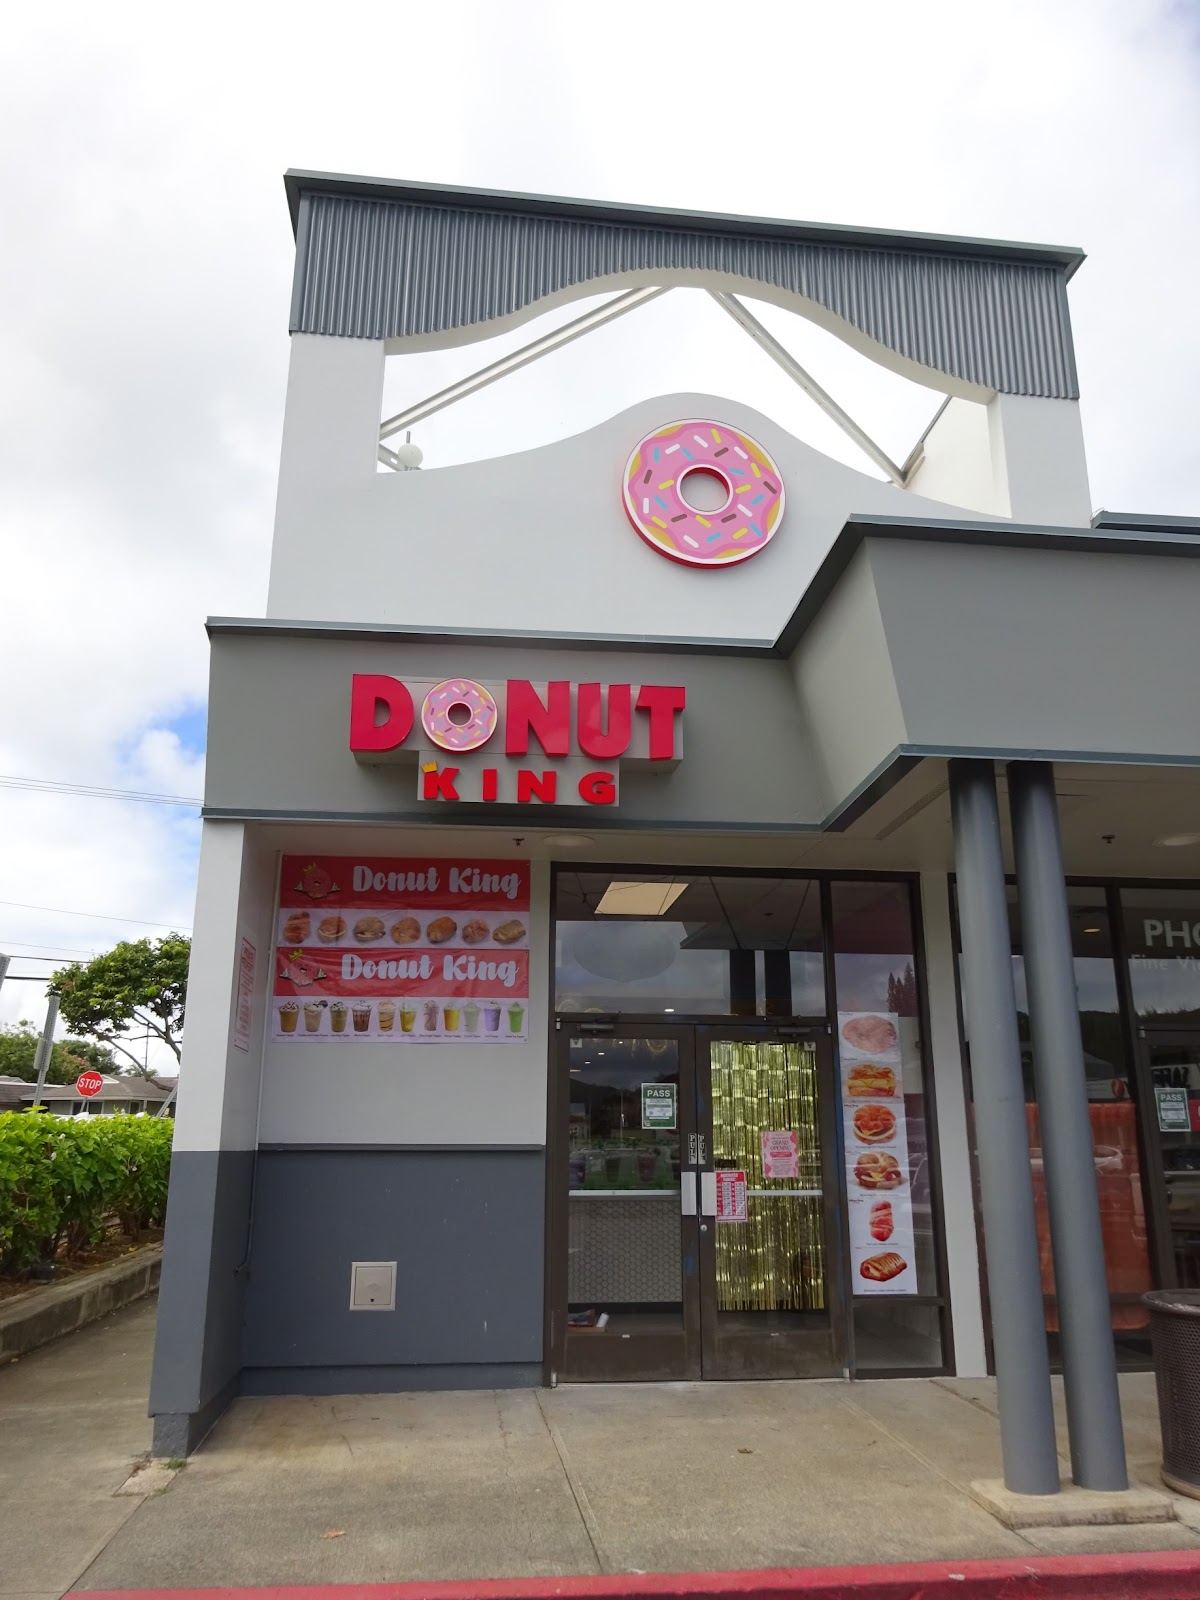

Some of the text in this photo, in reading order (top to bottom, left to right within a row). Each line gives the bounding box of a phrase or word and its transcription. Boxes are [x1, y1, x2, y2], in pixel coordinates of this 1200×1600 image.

[423, 767, 616, 805] KING
[353, 866, 520, 899] Donut King
[341, 953, 519, 987] Donut King
[1176, 954, 1200, 972] Vi
[78, 1078, 102, 1090] STOP
[647, 1089, 671, 1098] PASS
[1160, 1094, 1183, 1102] PASS
